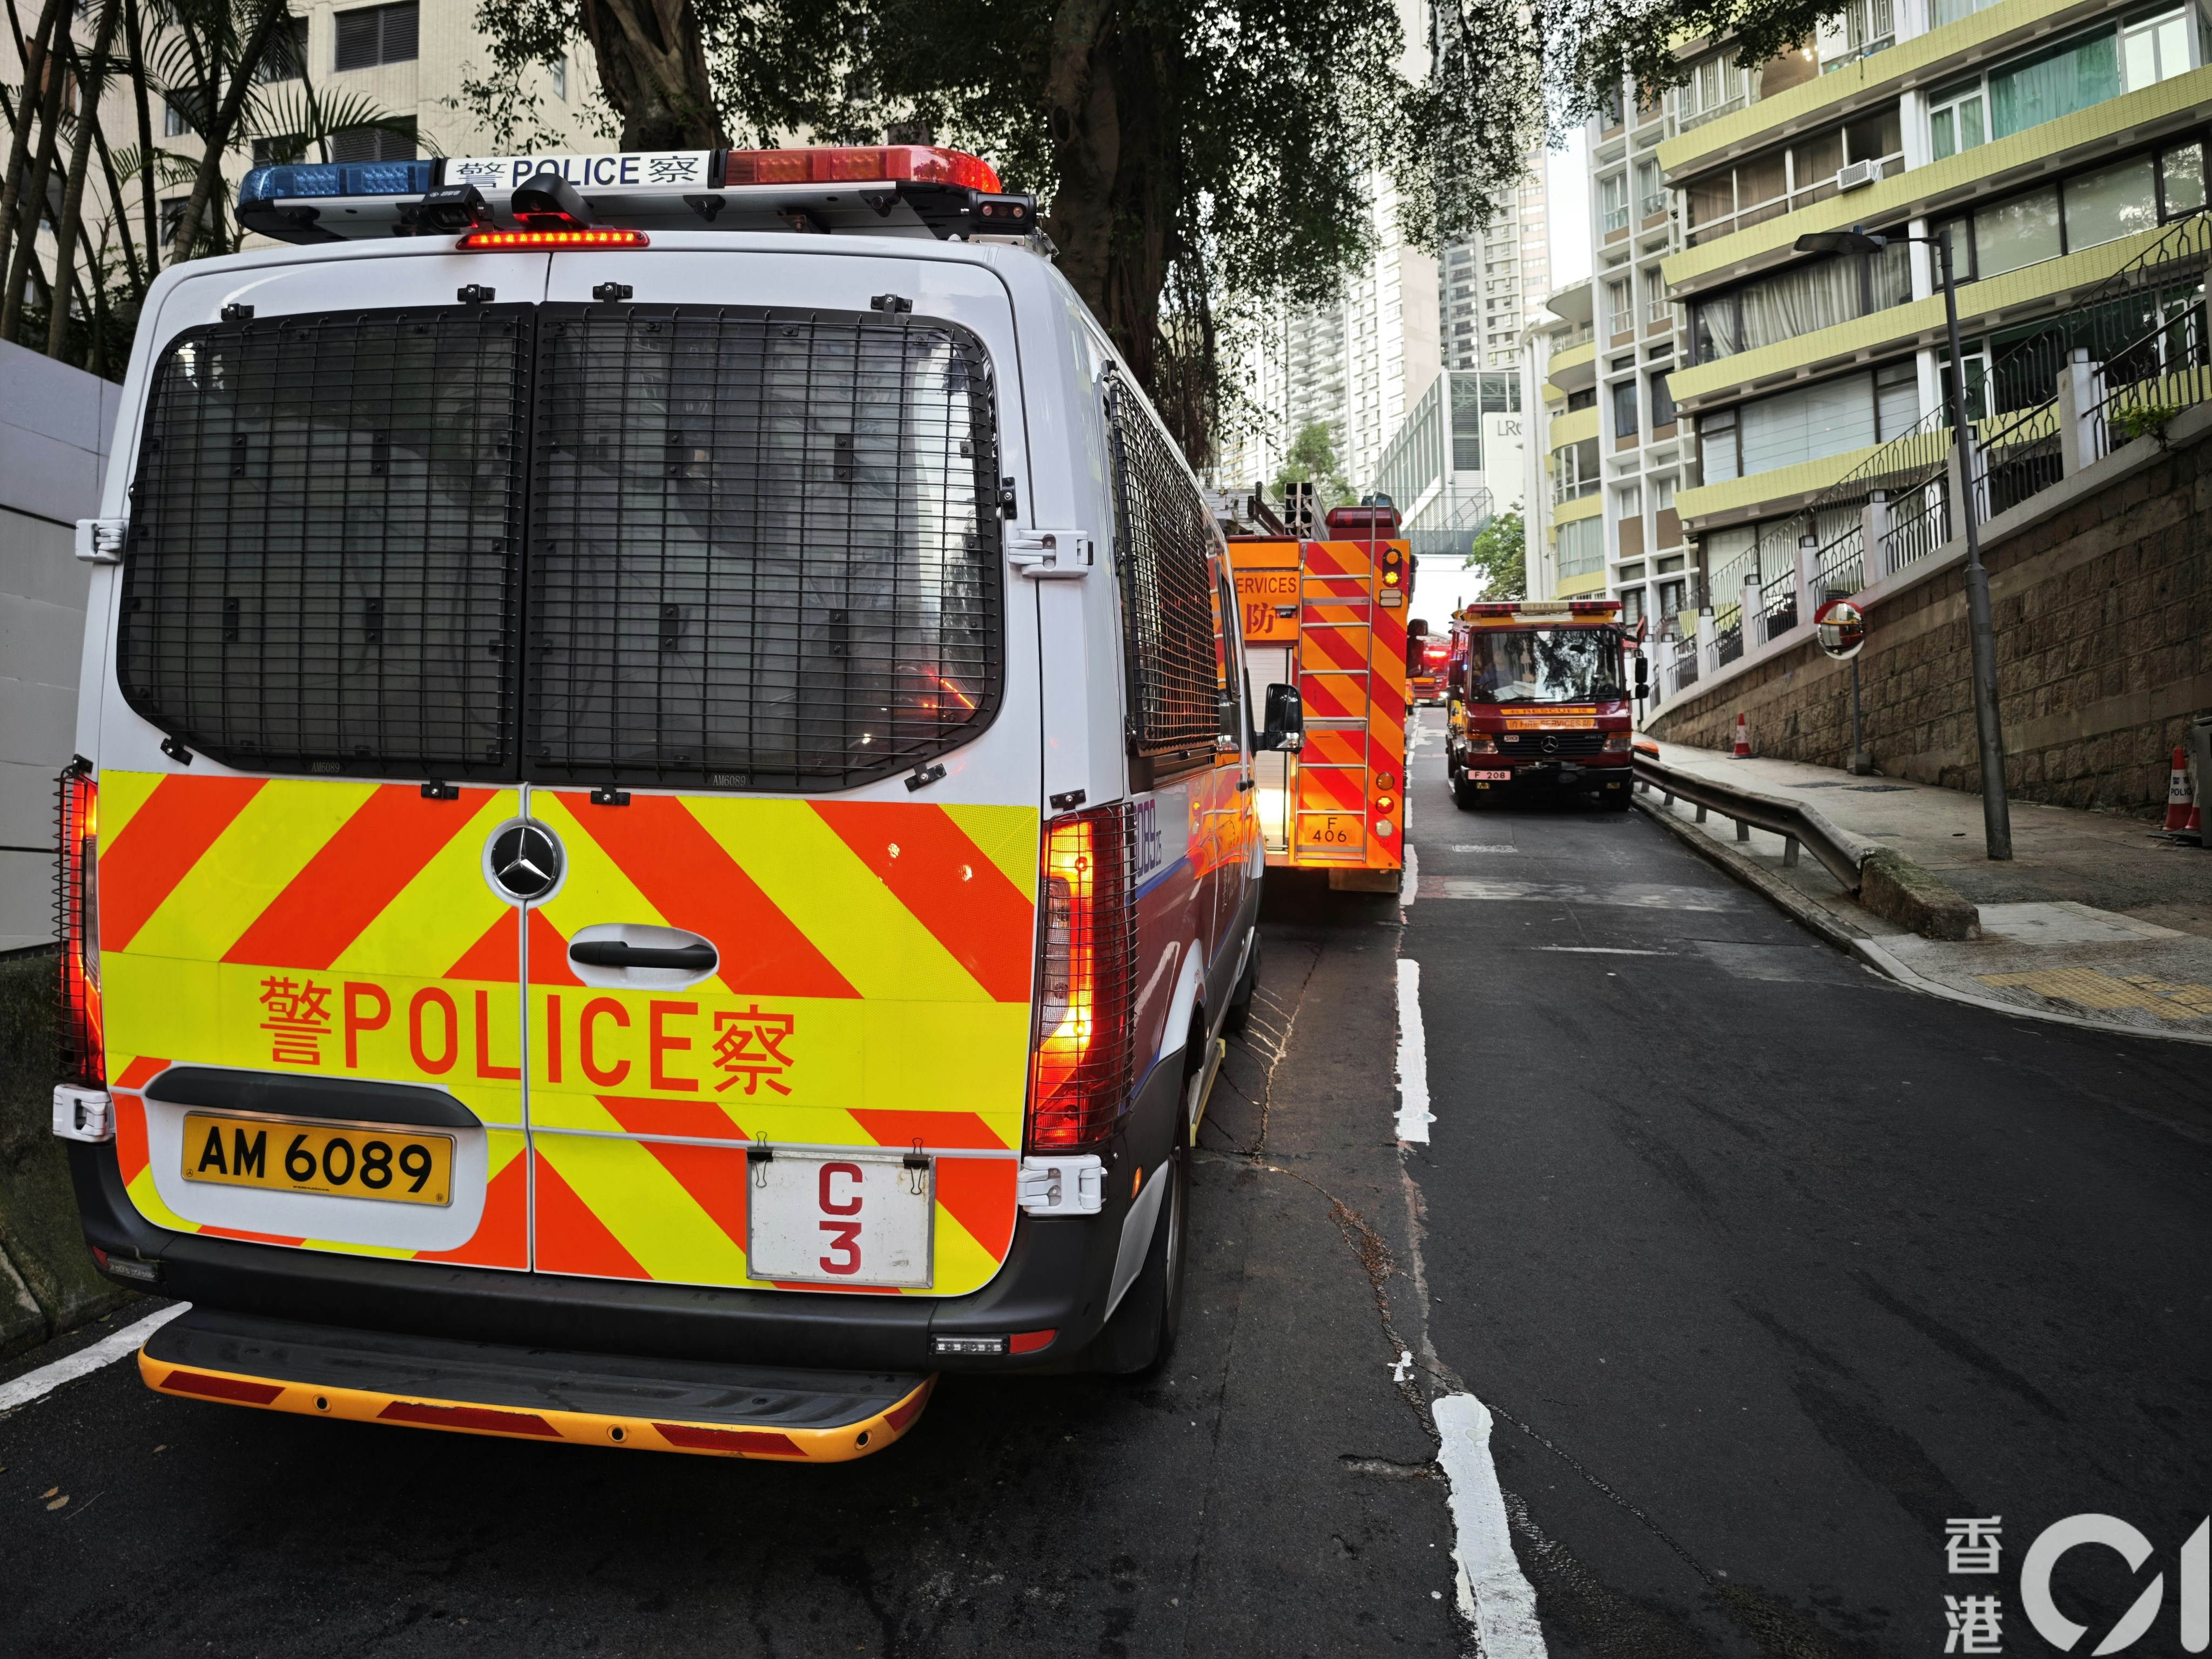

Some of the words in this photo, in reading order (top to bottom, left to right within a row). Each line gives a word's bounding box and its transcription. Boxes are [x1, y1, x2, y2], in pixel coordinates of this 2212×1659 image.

[456, 162, 507, 188] 警
[512, 156, 642, 187] POLICE
[648, 156, 699, 183] 察
[1236, 577, 1297, 594] ERVICES
[1246, 602, 1276, 634] 防
[312, 762, 340, 773] AM6089
[713, 774, 746, 786] AM6089
[2170, 788, 2193, 796] POLIC
[1327, 818, 1337, 829] F
[1313, 830, 1347, 842] 406
[259, 975, 332, 1065] 警
[343, 981, 699, 1092] POLICE
[712, 1004, 795, 1096] 察
[198, 1126, 267, 1178] AM
[285, 1135, 433, 1193] 6089
